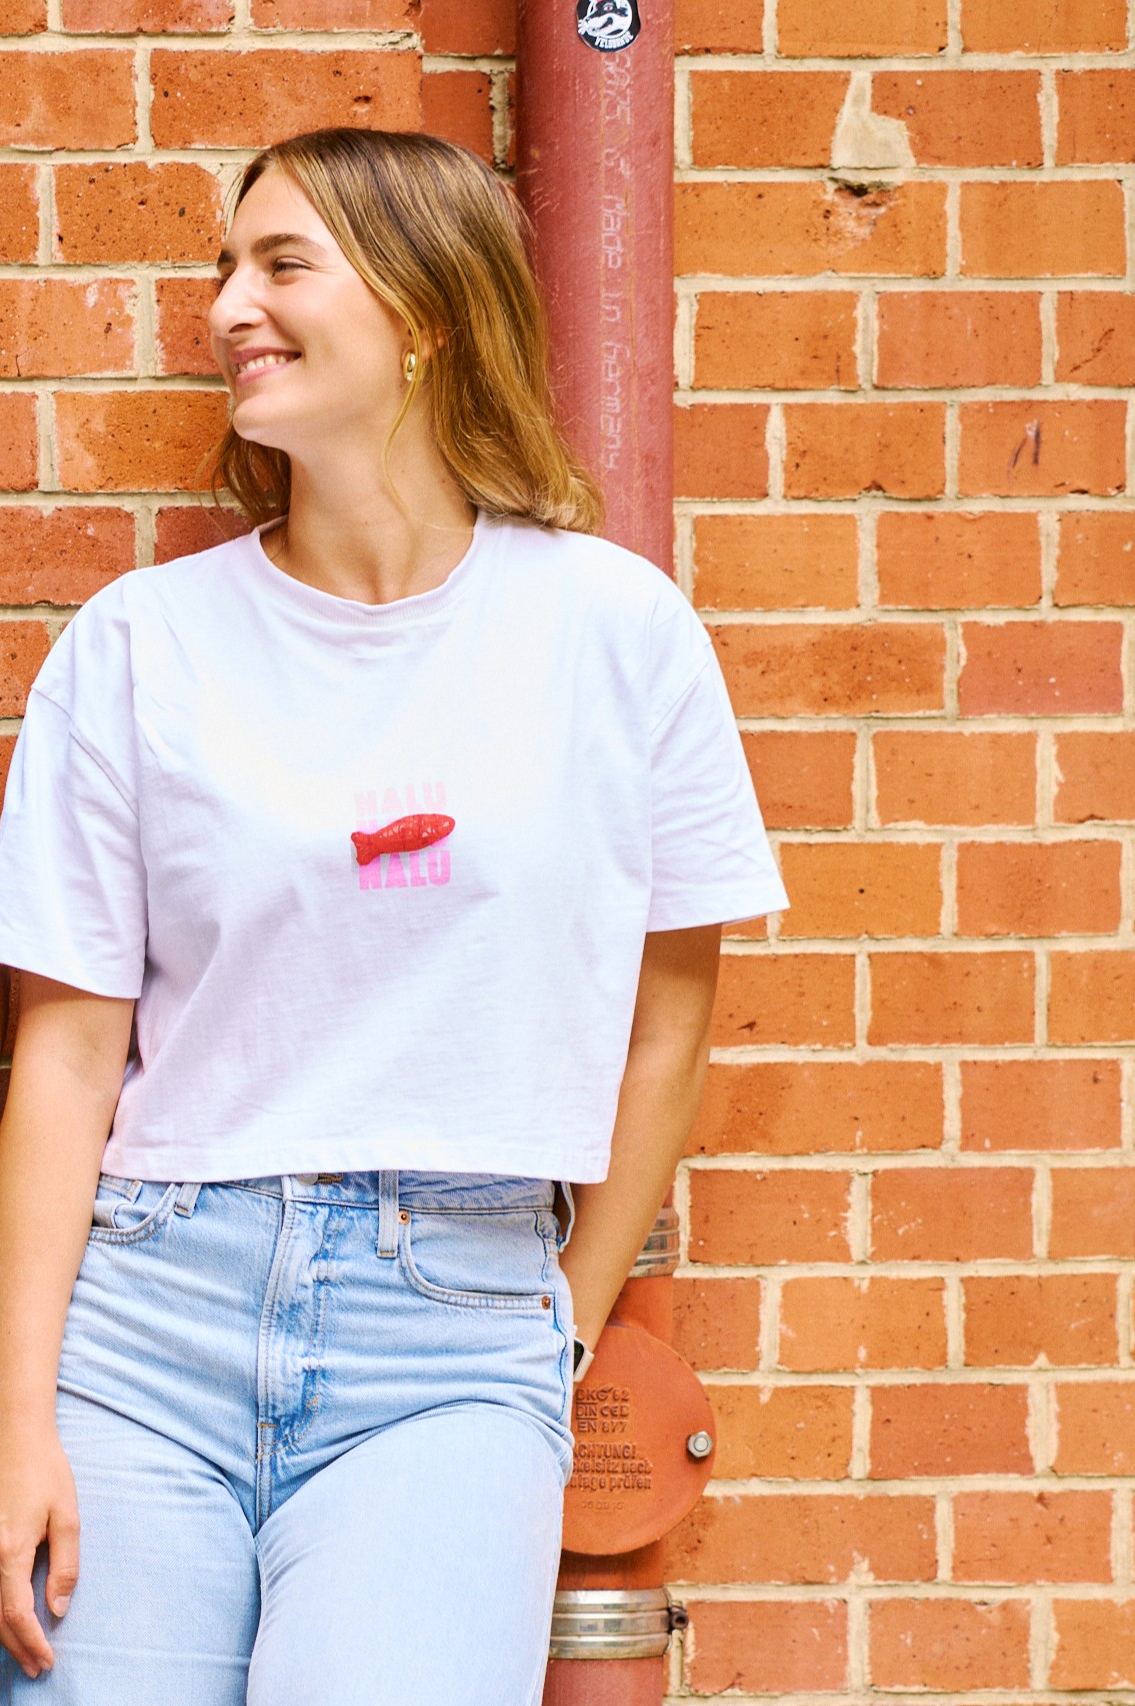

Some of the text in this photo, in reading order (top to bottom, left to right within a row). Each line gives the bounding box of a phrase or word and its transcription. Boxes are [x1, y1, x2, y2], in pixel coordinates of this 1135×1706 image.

[602, 195, 629, 269] Made
[600, 340, 631, 470] Germany
[354, 782, 447, 817] NALU
[576, 1404, 597, 1416] DIN
[577, 1419, 597, 1433] EN
